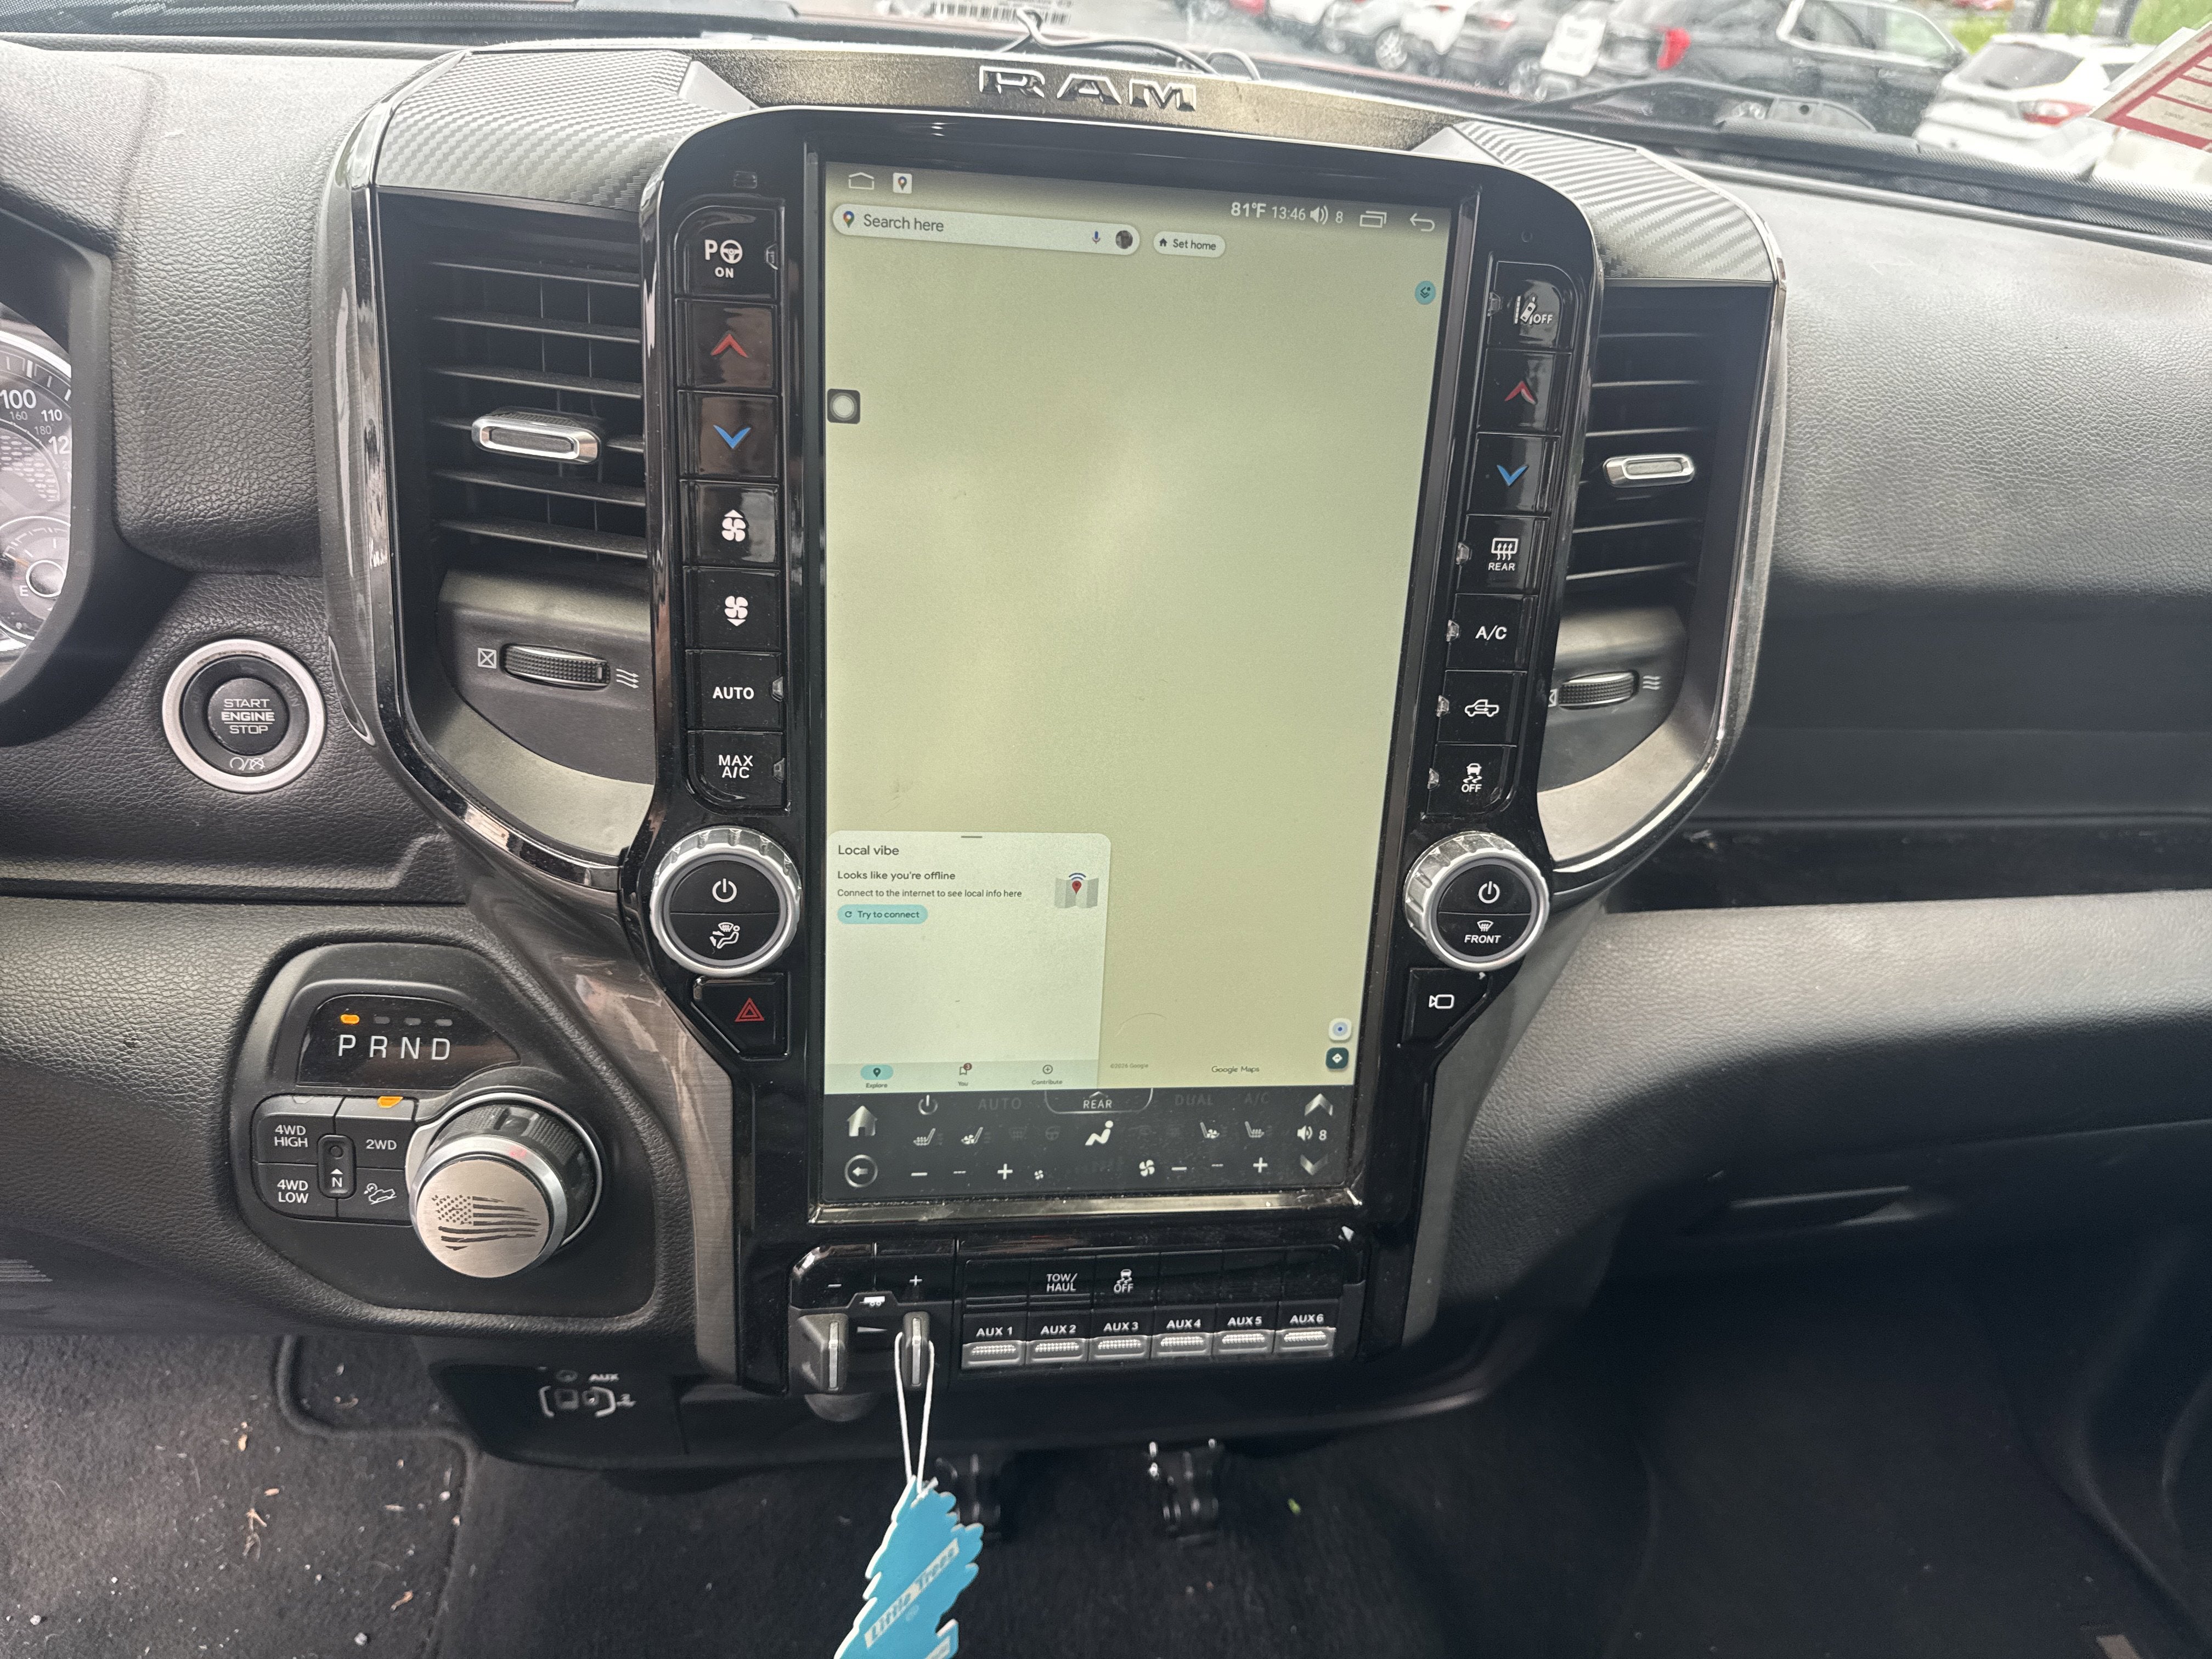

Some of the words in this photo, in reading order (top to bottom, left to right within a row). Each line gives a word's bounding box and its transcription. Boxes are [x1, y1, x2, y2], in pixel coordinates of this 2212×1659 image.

[979, 65, 1197, 111] RAM
[1271, 206, 1306, 221] 13:46
[1335, 211, 1344, 224] 8
[863, 213, 911, 230] Search
[913, 217, 944, 232] here
[704, 239, 718, 261] P
[1172, 238, 1189, 249] Set
[1190, 240, 1216, 251] home
[715, 267, 734, 279] ON
[1533, 313, 1554, 325] OFF
[0, 389, 37, 409] 100
[9, 410, 28, 421] 160
[41, 409, 63, 422] 110
[34, 425, 52, 435] 180
[48, 435, 71, 455] 12
[1487, 562, 1515, 572] REAR
[19, 585, 29, 597] E
[1475, 625, 1508, 641] A/C
[280, 682, 301, 708] RUN
[712, 686, 754, 700] AUTO
[223, 698, 270, 708] START
[221, 712, 275, 722] ENGINE
[229, 725, 268, 735] STOP
[718, 754, 754, 767] MAX
[721, 767, 750, 778] A/C
[1461, 783, 1482, 793] OFF
[838, 845, 870, 856] Local
[873, 845, 900, 856] vibe
[837, 871, 868, 880] Looks
[870, 871, 888, 880] like
[890, 871, 922, 882] you're
[924, 871, 956, 881] offline
[837, 889, 873, 898] Connect
[885, 889, 900, 898] the
[902, 889, 935, 898] internet
[964, 889, 984, 898] local
[986, 889, 1002, 898] info
[1003, 889, 1023, 898] here
[857, 911, 872, 920] Try
[884, 911, 920, 919] connect
[1464, 934, 1502, 944] FRONT
[337, 1034, 357, 1057] P
[369, 1035, 388, 1058] R
[400, 1036, 421, 1059] N
[431, 1037, 450, 1060] D
[1211, 1065, 1239, 1075] Google
[1240, 1065, 1260, 1074] Maps
[978, 1098, 1023, 1111] AUTO
[1082, 1099, 1113, 1109] REAR
[274, 1125, 306, 1136] 4WD
[1318, 1129, 1328, 1141] 8
[274, 1136, 309, 1148] HIGH
[365, 1139, 397, 1150] 2WD
[277, 1180, 309, 1190] 4WD
[331, 1177, 343, 1188] N
[278, 1192, 309, 1204] LOW
[1046, 1273, 1078, 1283] TOW/
[1046, 1283, 1077, 1292] HAUL
[1114, 1283, 1134, 1294] OFF
[1166, 1320, 1194, 1329] AUX
[1194, 1319, 1201, 1329] 4
[1227, 1317, 1255, 1327] AUX
[1255, 1316, 1262, 1325] 5
[1289, 1314, 1316, 1324] AUX
[1317, 1313, 1324, 1323] 6
[975, 1327, 1003, 1337] AUX
[1008, 1326, 1013, 1336] 1
[1040, 1325, 1066, 1335] AUX
[1068, 1324, 1076, 1334] 2
[1103, 1322, 1131, 1332] AUX
[1132, 1322, 1139, 1331] 3
